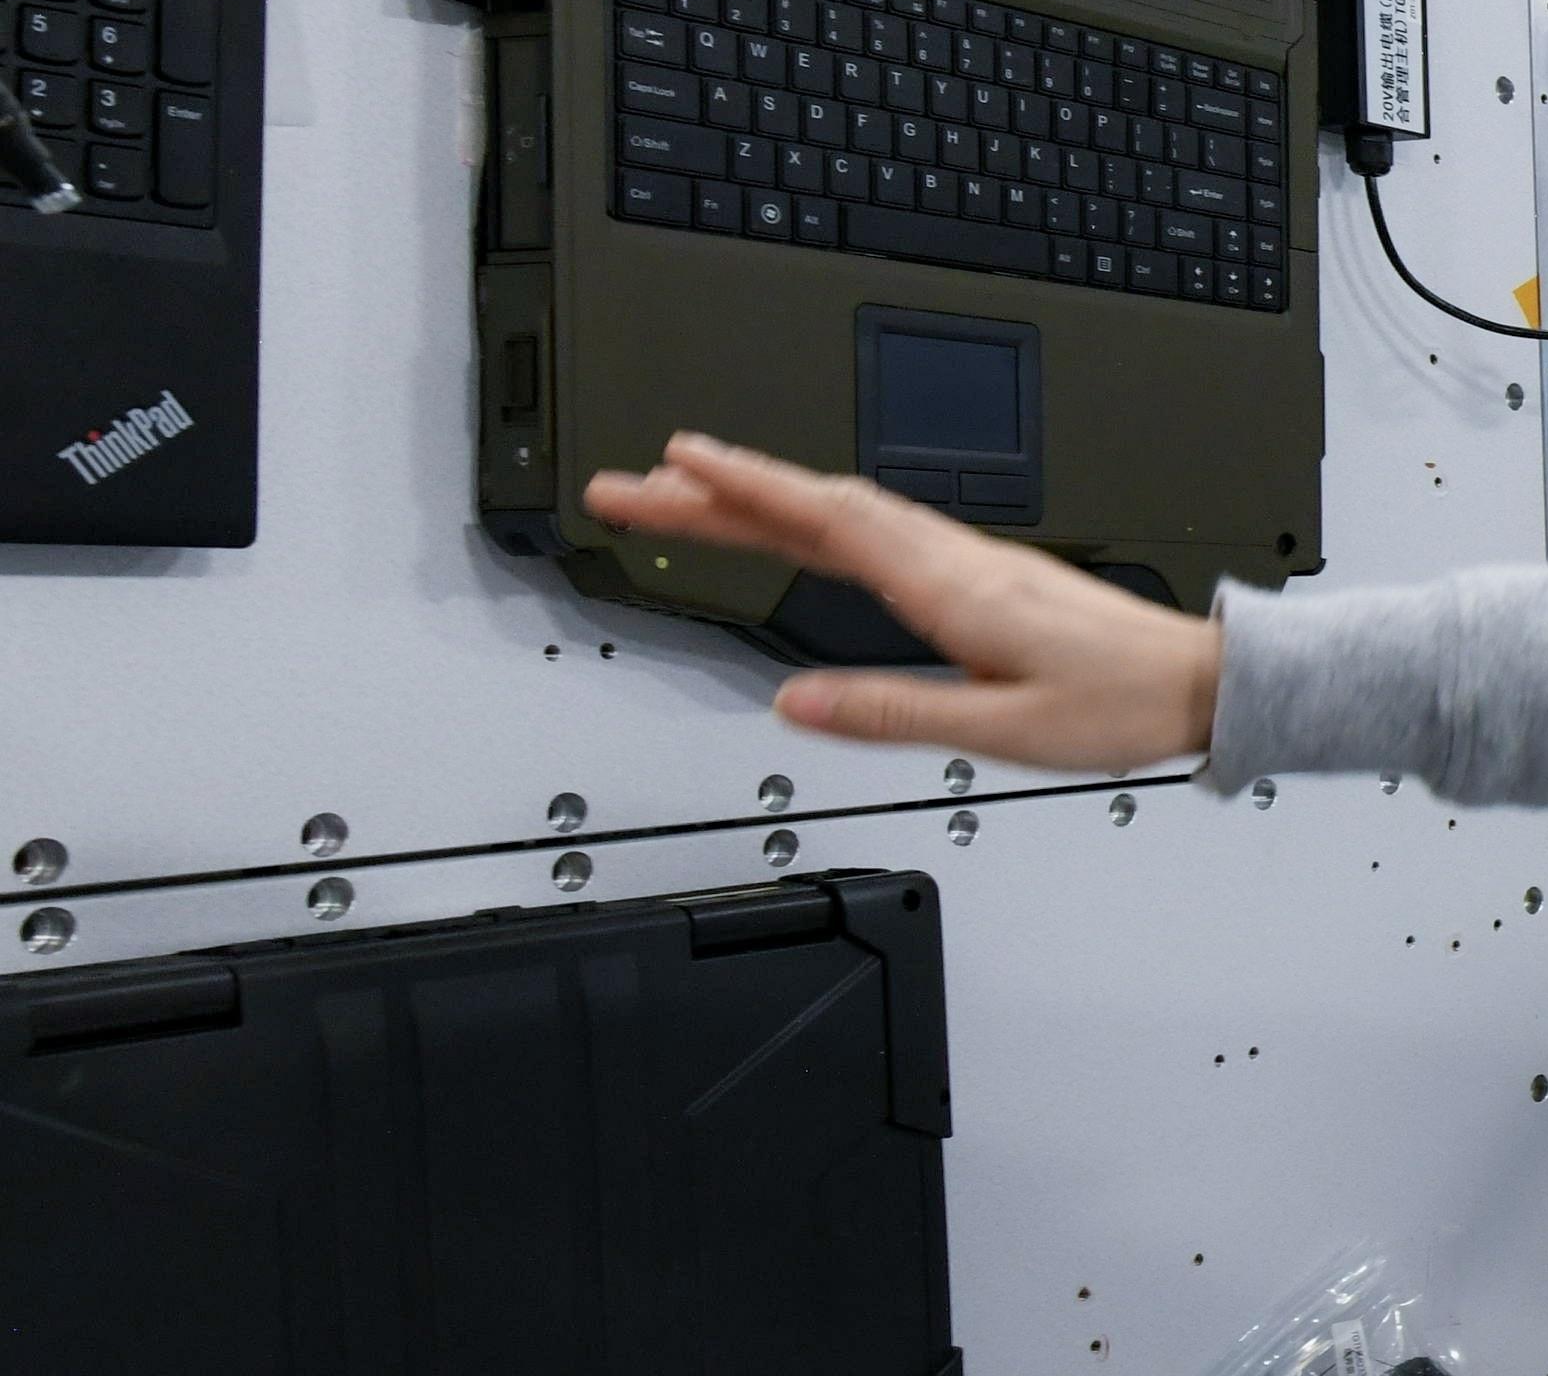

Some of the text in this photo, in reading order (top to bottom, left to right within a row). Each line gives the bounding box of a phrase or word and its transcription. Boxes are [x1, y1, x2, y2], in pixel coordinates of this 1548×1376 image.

[32, 13, 118, 45] 5 6
[731, 9, 883, 52] 2 3 4 5
[31, 78, 116, 108] 2 3
[700, 32, 714, 48] Q
[750, 43, 768, 58] W
[799, 52, 811, 68] E
[846, 63, 859, 78] R
[892, 71, 902, 87] T
[936, 81, 948, 96] Y
[977, 90, 989, 104] U
[1059, 107, 1073, 122] O
[1098, 115, 1109, 128] P
[714, 86, 728, 103] A
[763, 96, 776, 112] S
[811, 105, 824, 120] D
[858, 113, 869, 127] F
[903, 122, 916, 138] G
[946, 130, 959, 145] H
[990, 138, 1000, 152] J
[1030, 146, 1041, 161] K
[1069, 154, 1079, 168] L
[739, 141, 752, 158] Z
[787, 150, 801, 166] X
[835, 159, 849, 174] C
[882, 166, 894, 181] V
[925, 174, 938, 189] B
[968, 181, 980, 197] N
[1010, 188, 1024, 202] M
[57, 389, 195, 486] ThinkPad
